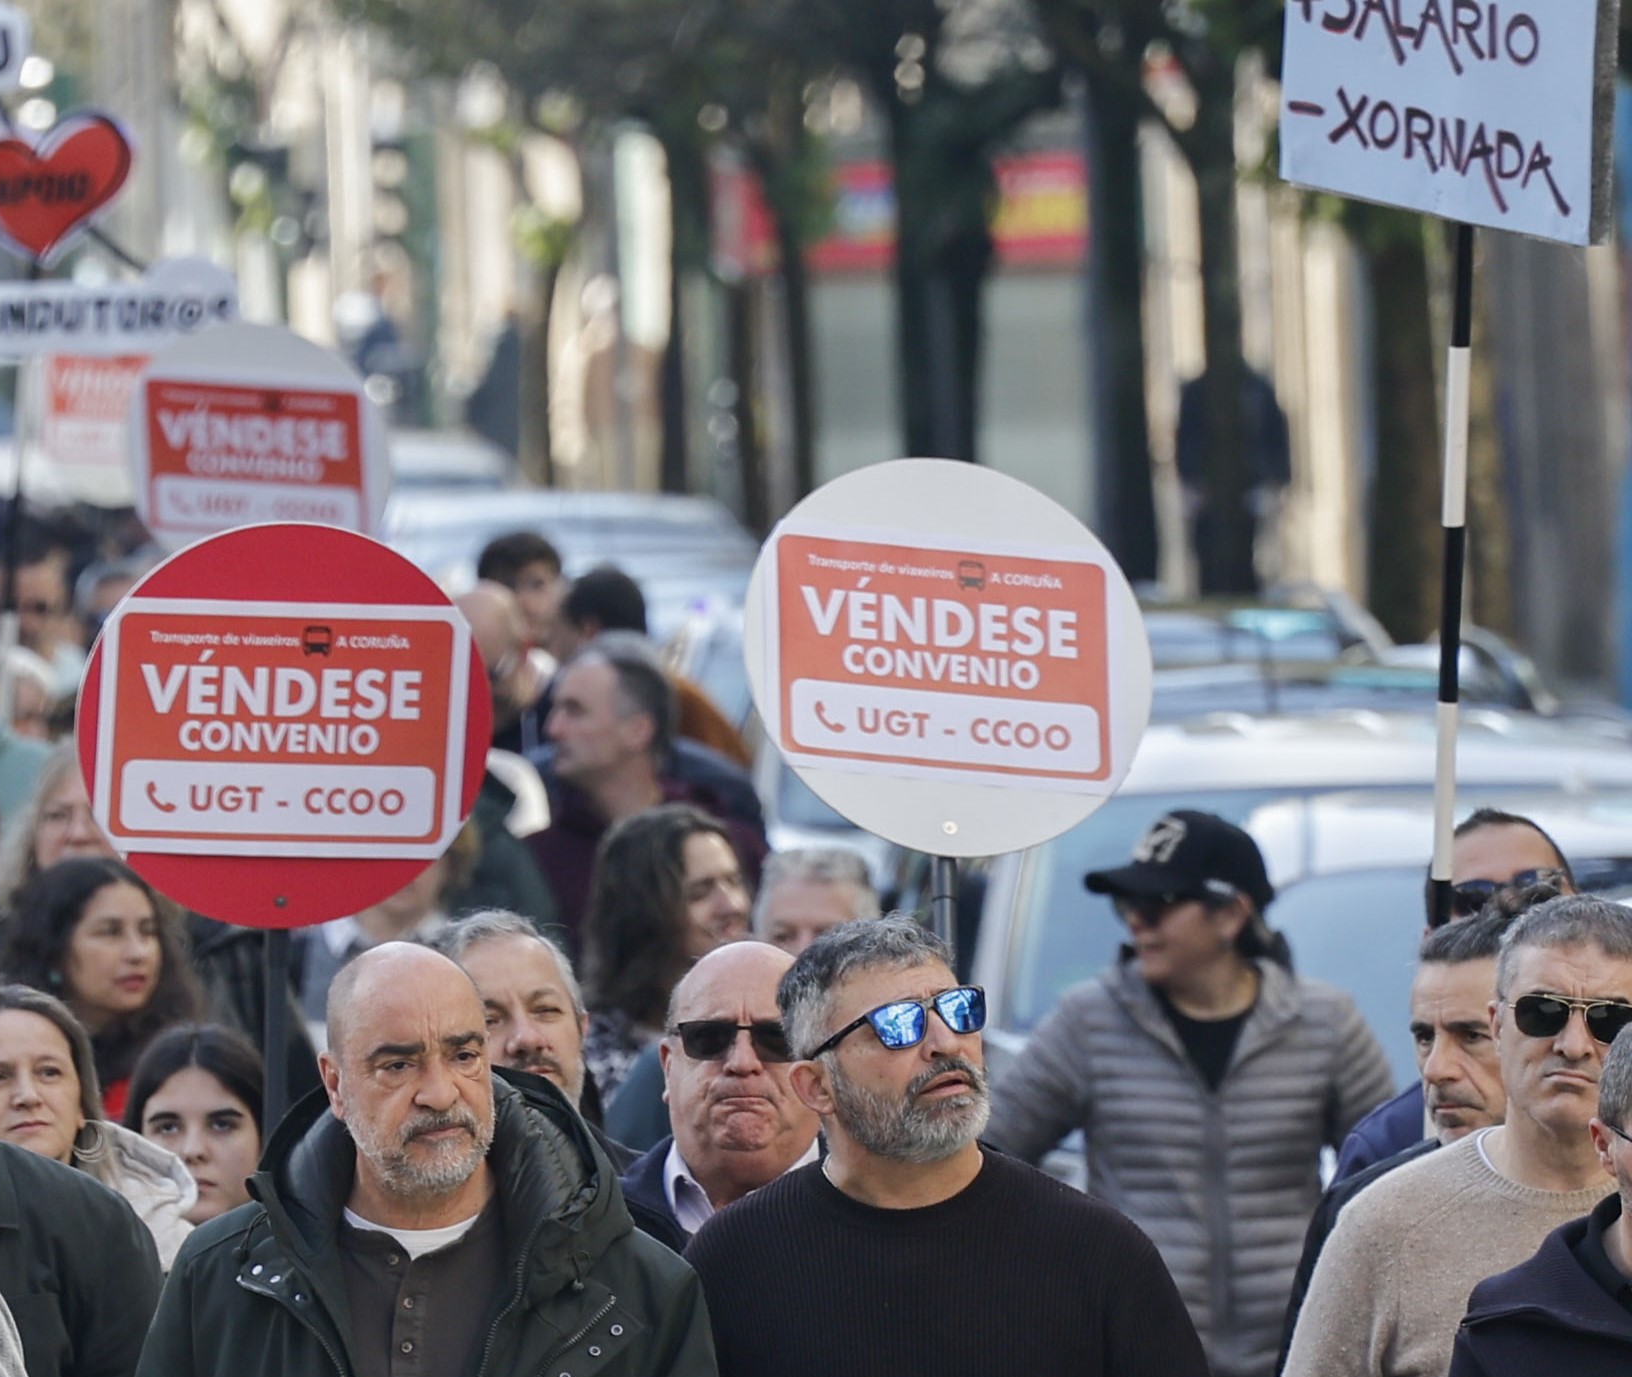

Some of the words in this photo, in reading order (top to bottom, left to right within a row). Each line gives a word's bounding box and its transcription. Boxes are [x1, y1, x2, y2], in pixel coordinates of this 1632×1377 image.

[156, 400, 348, 461] VÉNDESE
[808, 554, 876, 573] Transporte
[878, 561, 896, 575] de
[898, 563, 954, 580] viaxeiros
[991, 573, 1002, 585] A
[1003, 573, 1063, 590] CORUÑA
[150, 630, 220, 647] Transporte
[222, 631, 240, 646] de
[242, 632, 300, 647] viaxeiros
[336, 636, 348, 648] A
[349, 634, 410, 650] CORUÑA
[800, 576, 1079, 660] VÉNDESE
[140, 649, 423, 720] VÉNDESE
[842, 644, 1040, 690] CONVENIO
[178, 720, 380, 755] CONVENIO
[857, 706, 930, 739] UGT
[971, 717, 1071, 751] CCOO
[190, 784, 264, 812] UGT
[303, 787, 404, 816] CCOO
